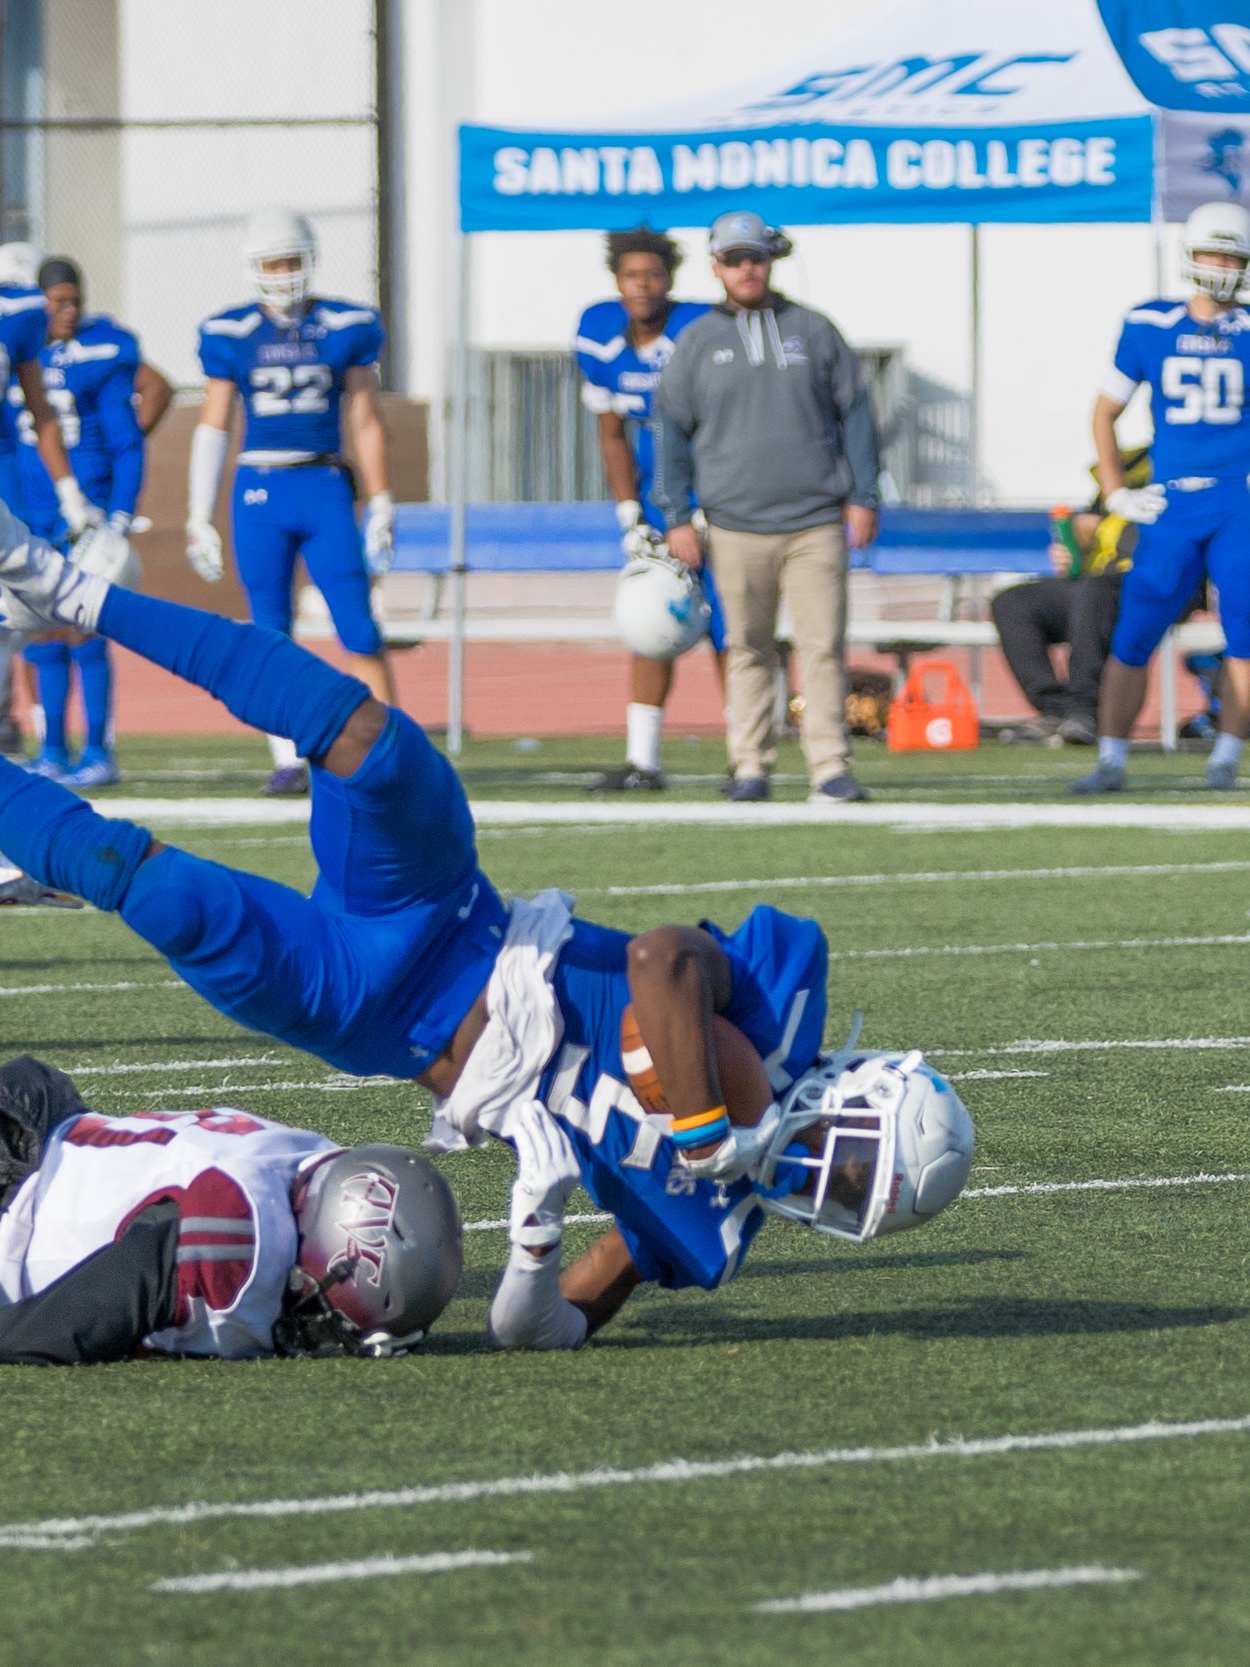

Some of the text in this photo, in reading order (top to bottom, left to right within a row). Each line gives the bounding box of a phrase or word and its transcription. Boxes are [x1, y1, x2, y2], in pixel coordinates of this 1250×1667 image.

[740, 51, 1078, 110] SMC
[493, 136, 1117, 196] SANTA MONICA COLLEGE
[251, 364, 331, 417] 22
[1162, 356, 1243, 425] 50
